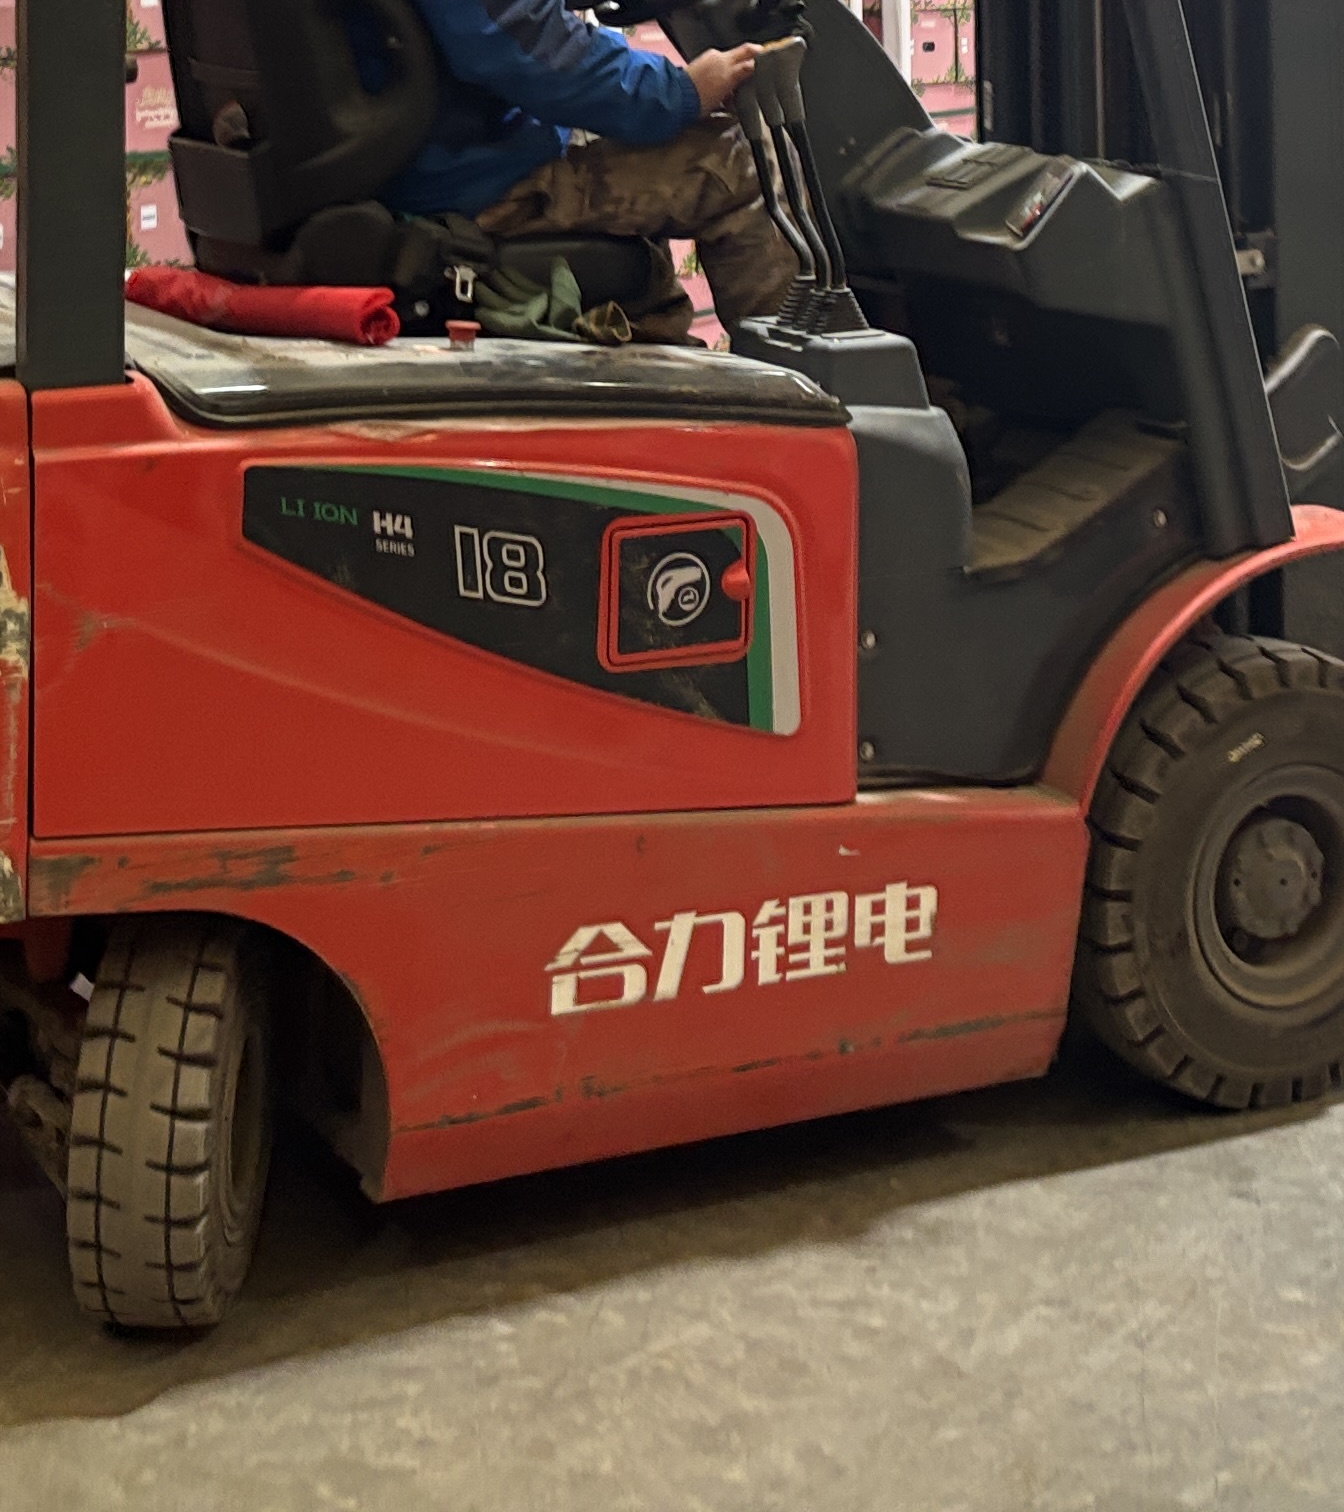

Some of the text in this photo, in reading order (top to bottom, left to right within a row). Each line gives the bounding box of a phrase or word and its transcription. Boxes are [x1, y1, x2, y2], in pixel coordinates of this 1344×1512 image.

[280, 496, 359, 526] LI ION
[372, 509, 414, 540] H4
[375, 538, 415, 558] SERIES
[454, 524, 548, 607] 18
[544, 879, 939, 1016] 合力锂电
